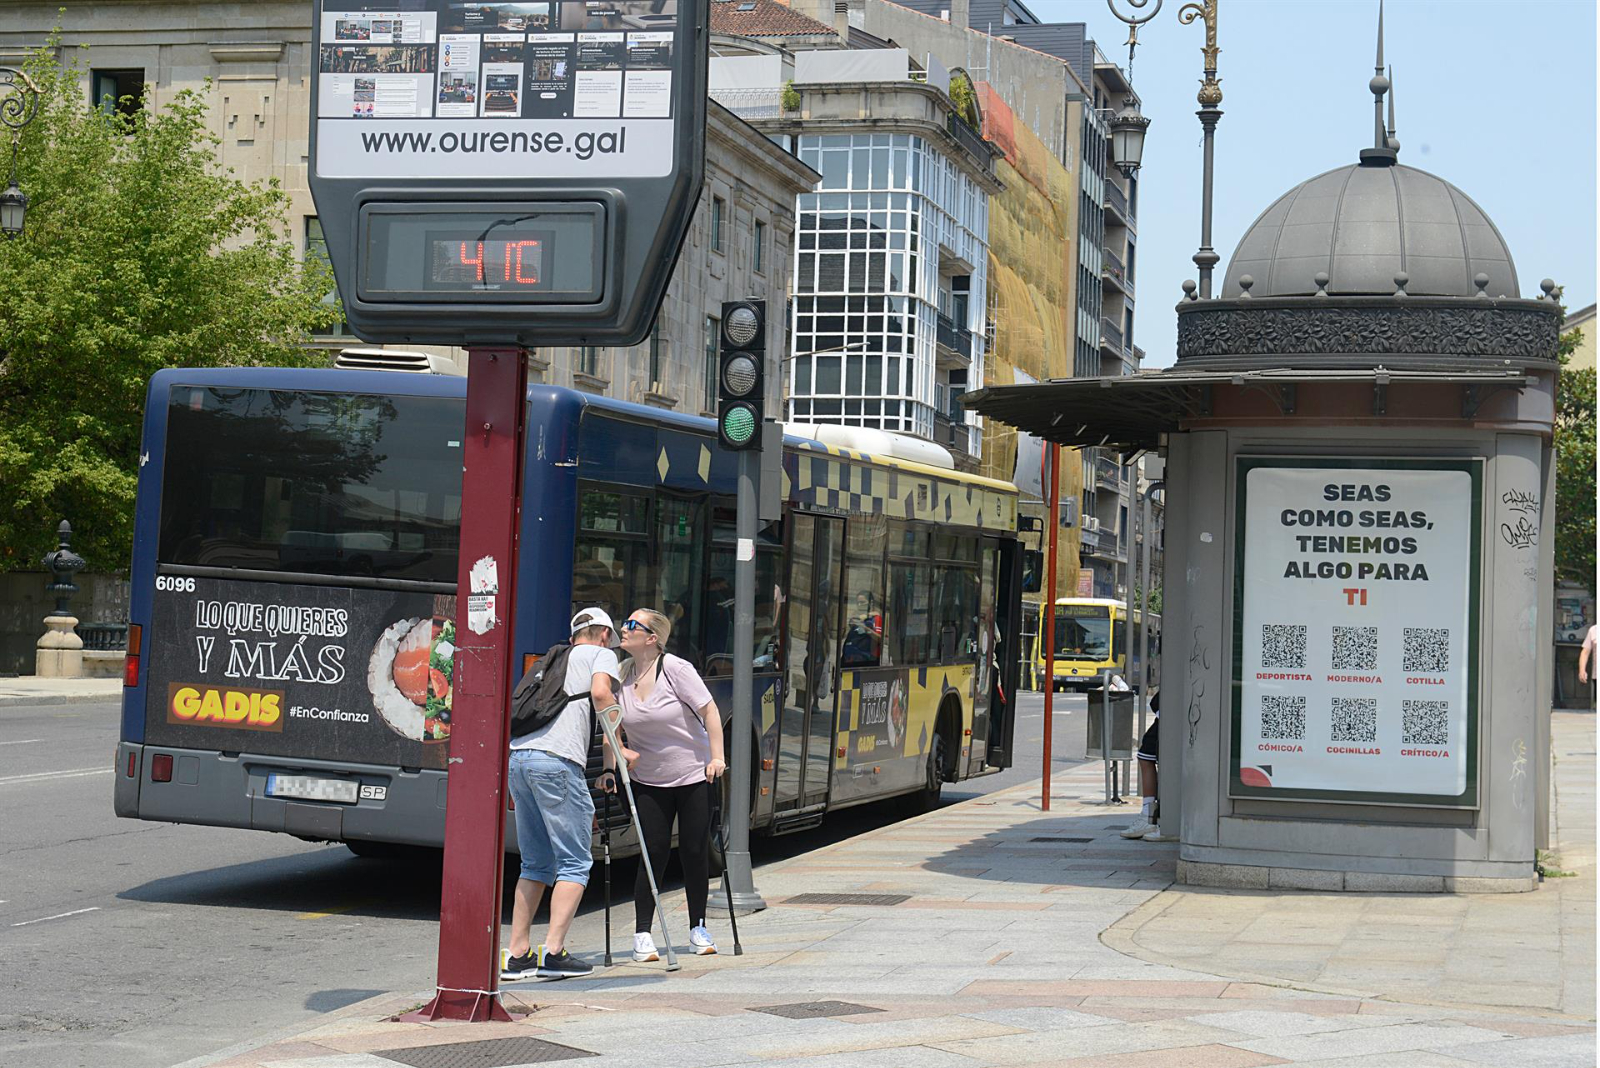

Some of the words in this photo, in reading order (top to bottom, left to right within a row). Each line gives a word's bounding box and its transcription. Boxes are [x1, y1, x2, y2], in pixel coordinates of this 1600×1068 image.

[361, 126, 626, 161] www.ourense.gal
[1323, 484, 1392, 502] SEAS
[1280, 509, 1353, 528] COMO
[1358, 510, 1434, 531] SEAS,
[1295, 535, 1418, 555] TENEMOS
[1283, 561, 1352, 579] ALGO
[1358, 562, 1429, 581] PARA
[155, 575, 196, 593] 6096
[1343, 588, 1367, 606] TI
[196, 600, 221, 629] LO
[223, 601, 264, 635] QUE
[265, 604, 348, 638] QUIERES
[197, 636, 214, 674] Y
[224, 634, 346, 684] MÁS
[1256, 671, 1313, 682] DEPORTISTA
[1327, 674, 1383, 684] MODERNO/A
[1406, 677, 1446, 686] COTILLA
[171, 686, 281, 728] GADIS
[289, 706, 369, 724] #EnConfianza
[1258, 743, 1303, 753] CÓMICO/A
[1326, 746, 1381, 756] COCINILLAS
[1400, 747, 1450, 758] CRÍTICO/A
[361, 786, 384, 798] SP
